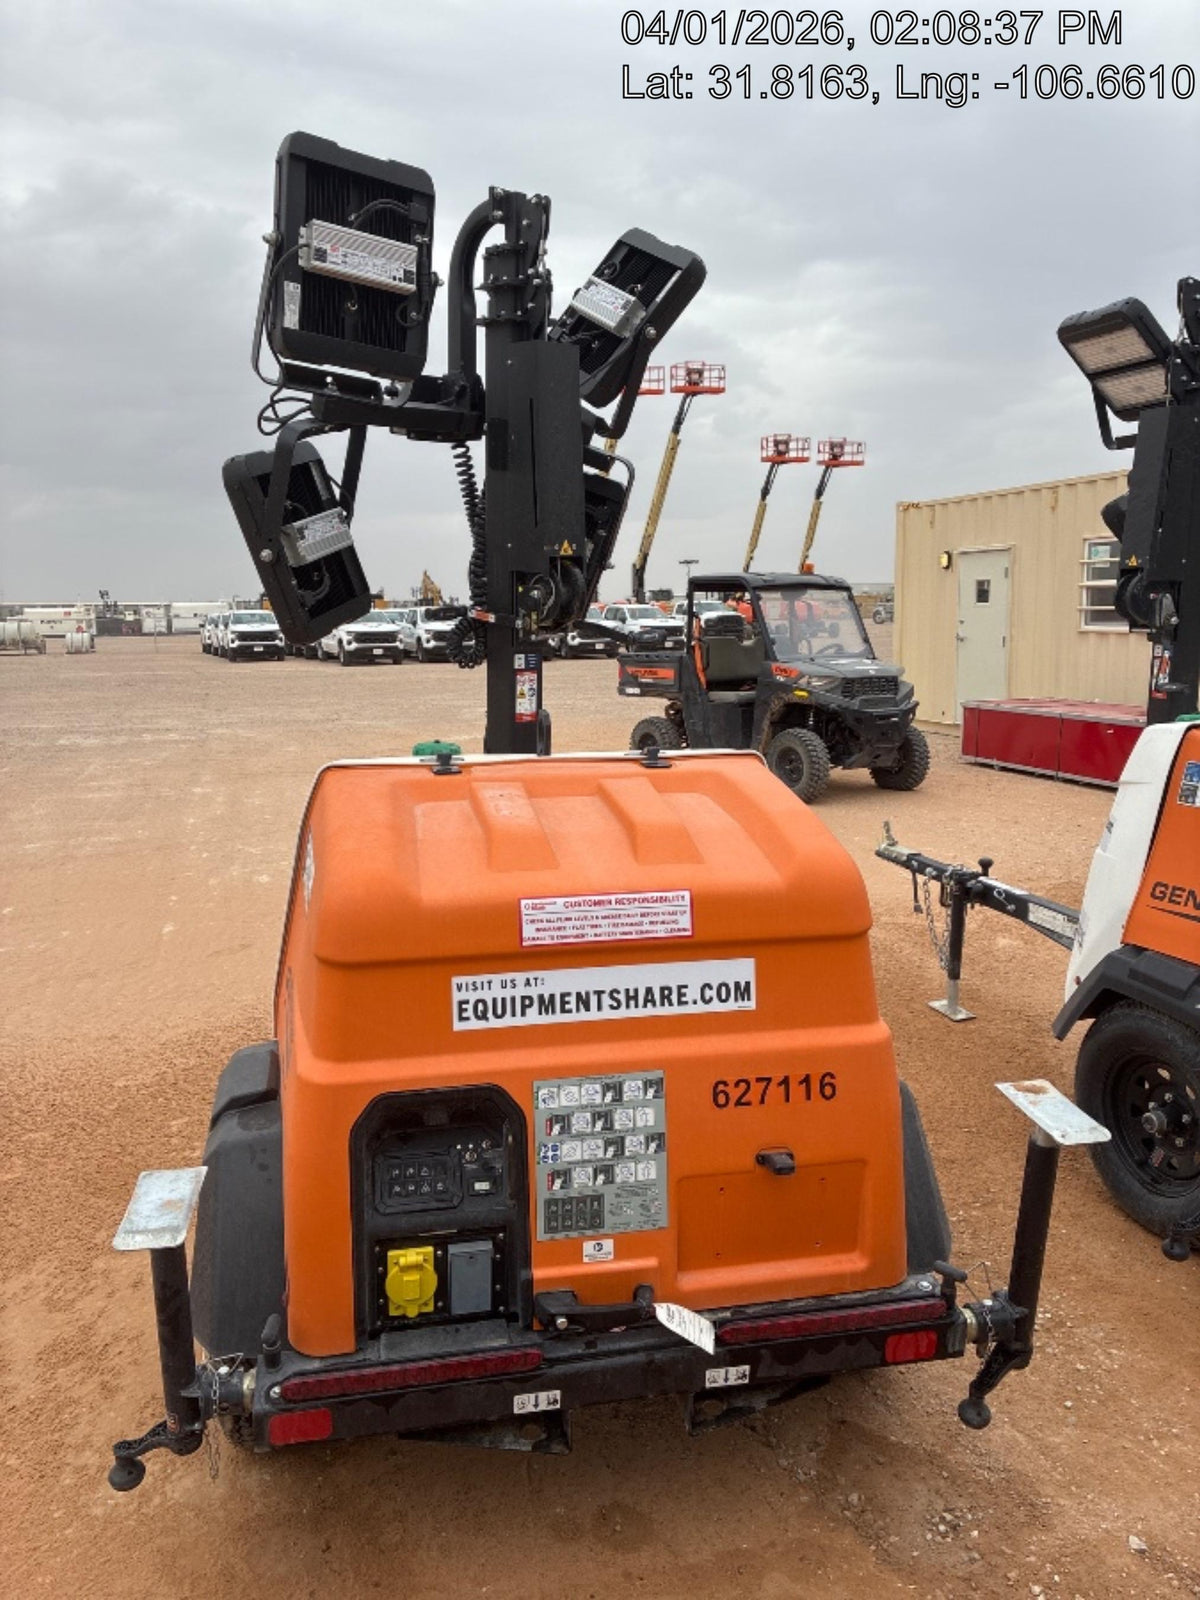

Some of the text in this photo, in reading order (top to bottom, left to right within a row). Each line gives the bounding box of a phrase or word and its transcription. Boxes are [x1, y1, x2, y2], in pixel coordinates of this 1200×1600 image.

[563, 898, 612, 909] CUSTOMER
[615, 895, 685, 906] RESPONSIBILITY
[456, 977, 545, 992] VISIT US AT:
[457, 980, 751, 1023] EQUIPMENTSHARE.COM
[712, 1071, 837, 1110] 627116
